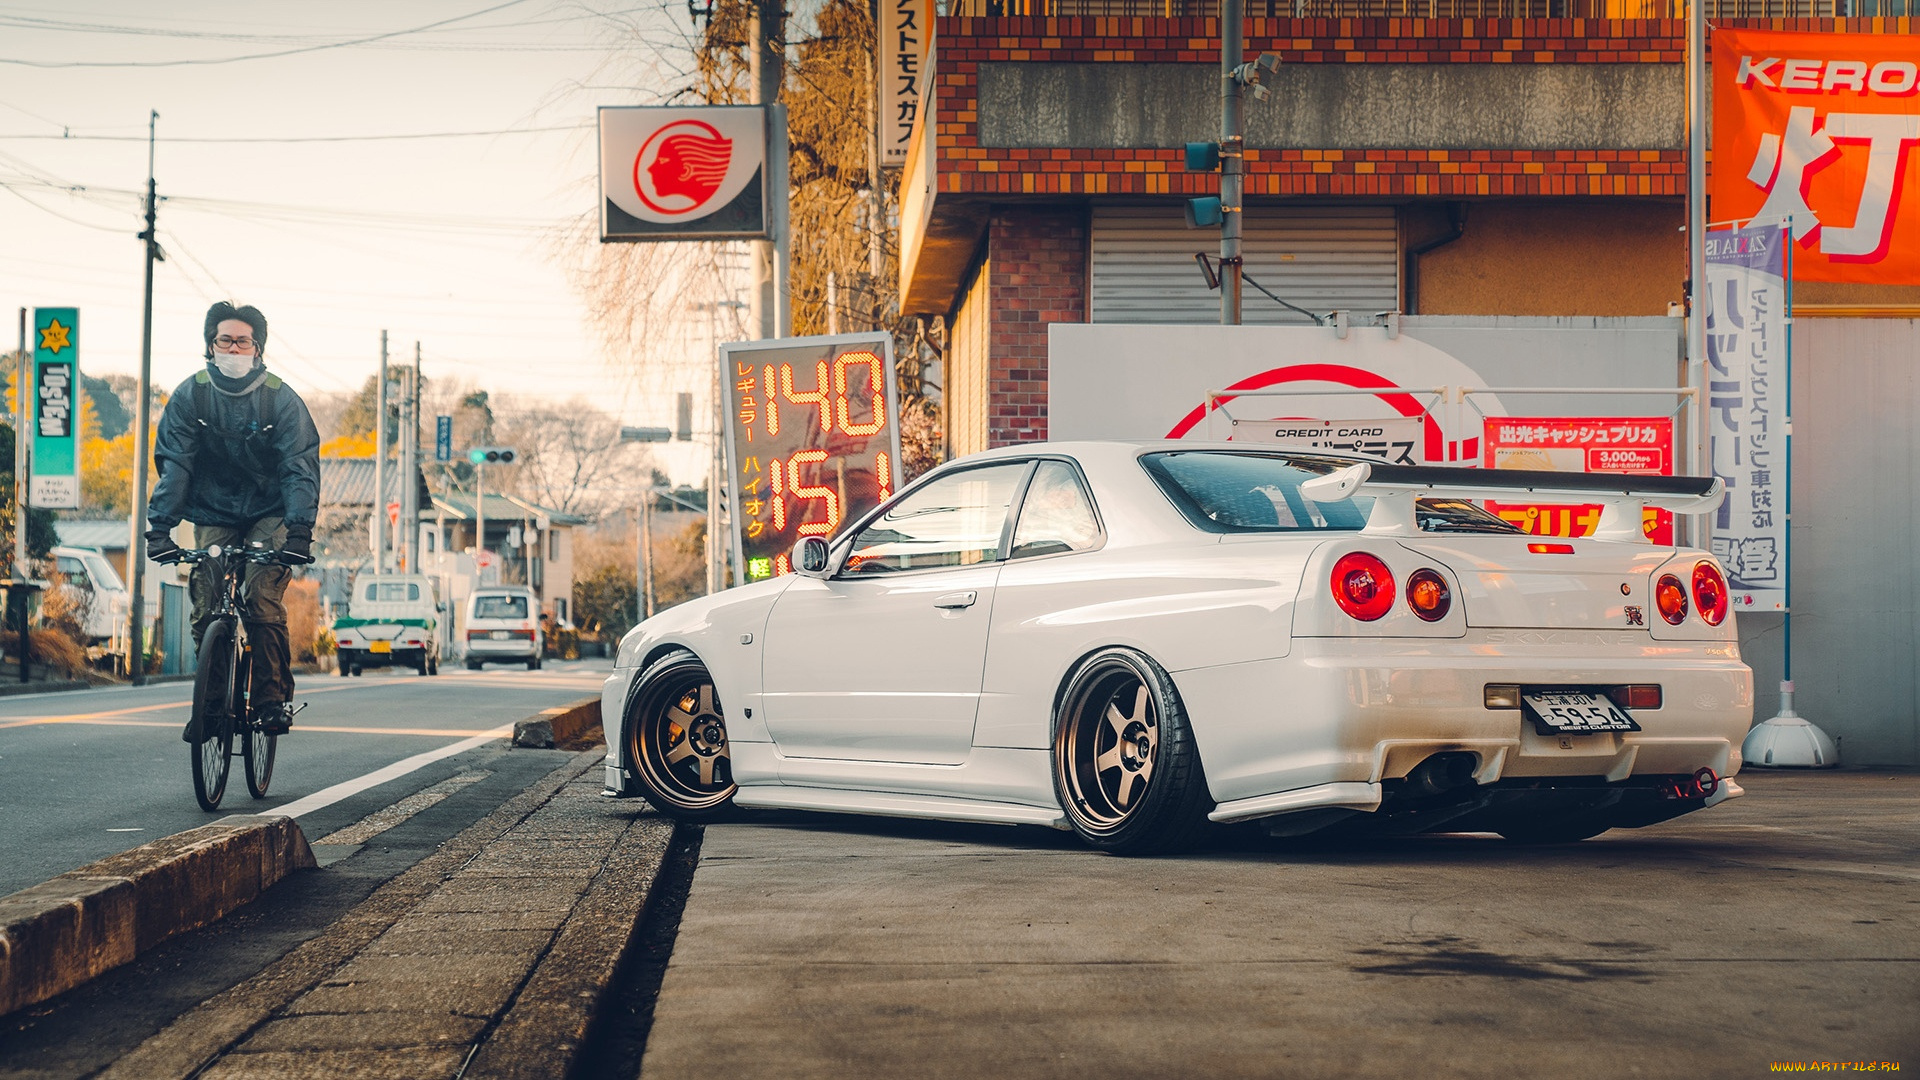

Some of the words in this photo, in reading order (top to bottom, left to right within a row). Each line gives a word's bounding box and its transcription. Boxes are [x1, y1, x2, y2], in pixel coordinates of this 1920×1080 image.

[1735, 55, 1920, 93] KERO
[1744, 106, 1920, 255] 灯
[737, 361, 757, 442] レギュラー
[763, 352, 885, 437] 140
[1275, 429, 1333, 438] CREDIT
[1337, 428, 1383, 437] CARD
[1499, 425, 1657, 444] 出光キャッシュプリカ
[743, 456, 764, 538] ハイオク
[770, 450, 891, 536] 151
[749, 557, 771, 578] 軽
[1572, 694, 1593, 705] 301
[1551, 707, 1627, 725] 59-54
